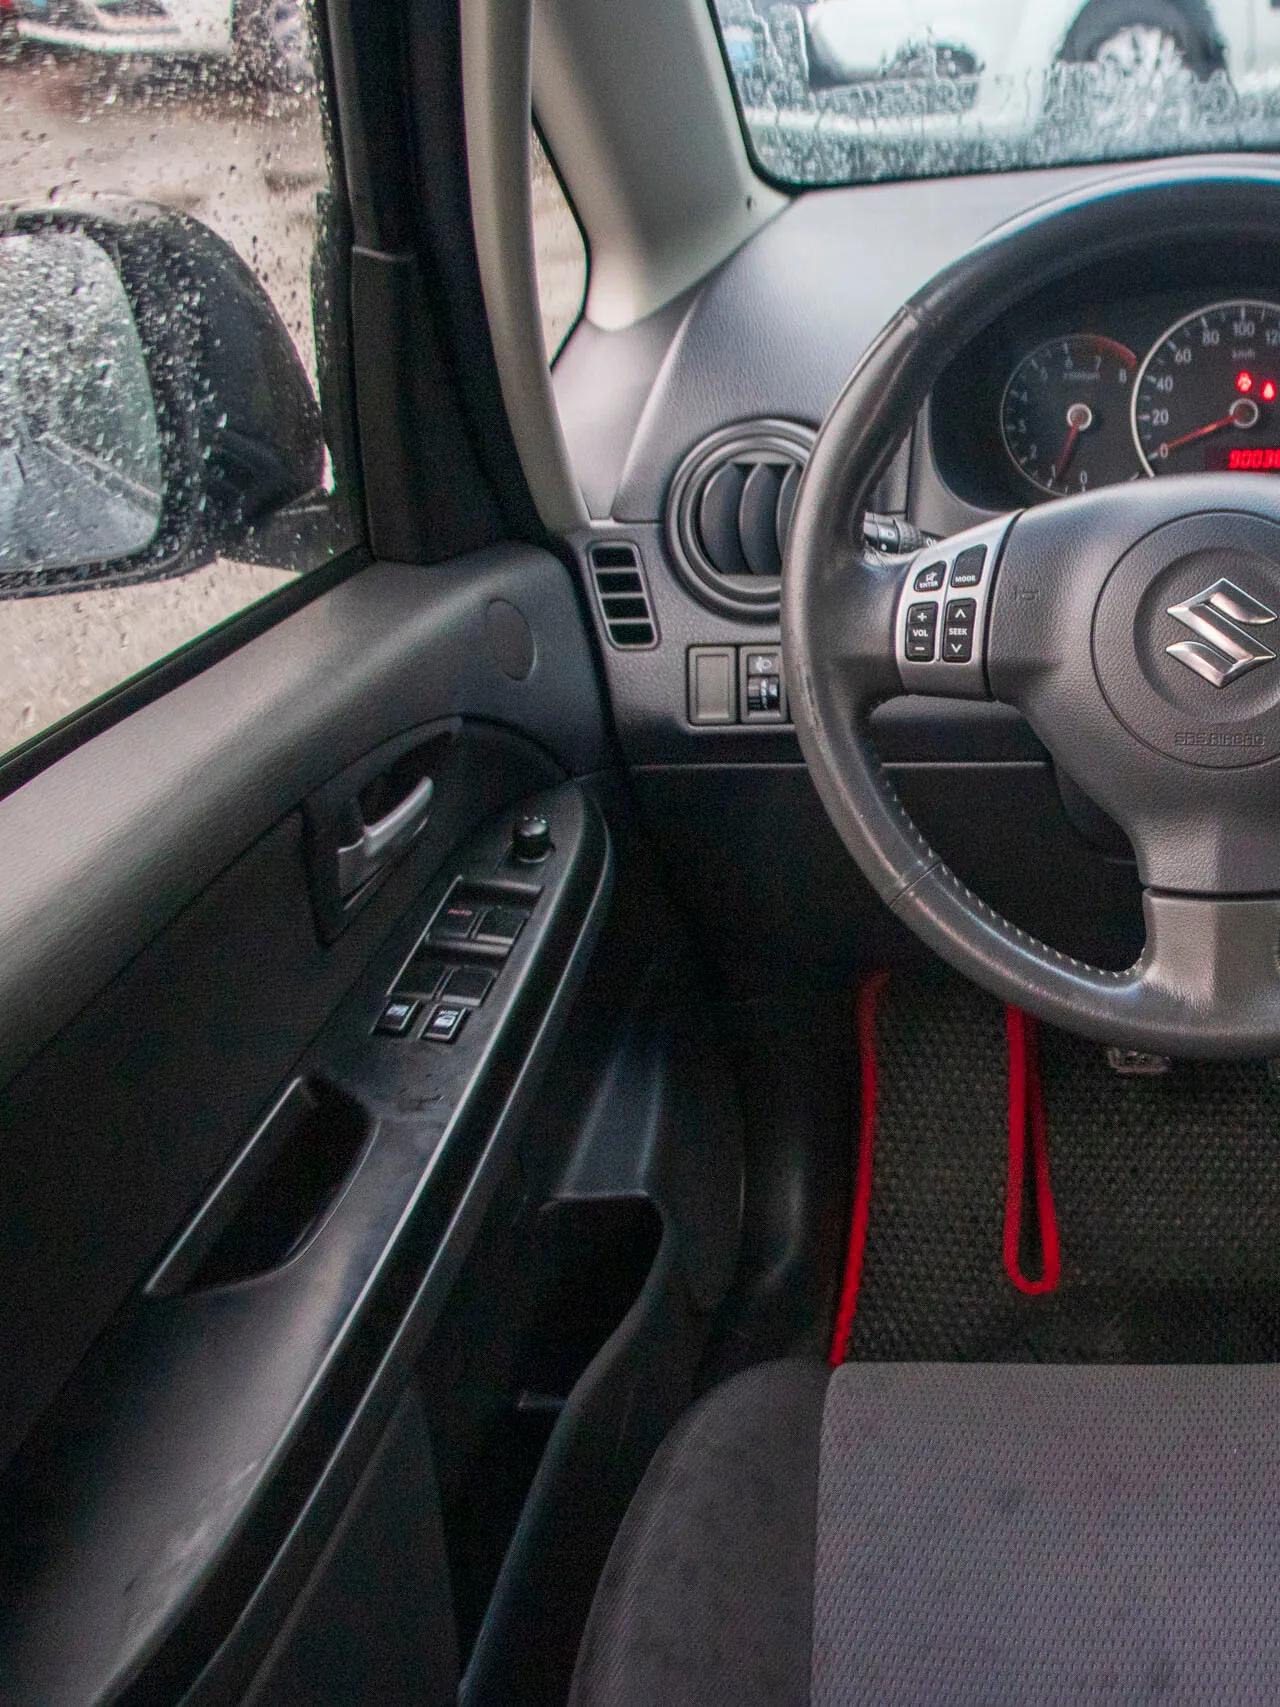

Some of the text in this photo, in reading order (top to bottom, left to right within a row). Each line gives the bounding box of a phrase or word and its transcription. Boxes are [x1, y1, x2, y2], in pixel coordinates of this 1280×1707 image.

[1232, 321, 1256, 337] 100
[1202, 331, 1220, 345] 80
[1174, 349, 1192, 363] 60
[1156, 376, 1174, 392] 40
[1152, 409, 1169, 425] 20
[955, 575, 977, 583] MODE
[912, 629, 929, 637] VOL
[948, 627, 968, 636] SEEK
[1174, 732, 1266, 747] SRS AIRBAG
